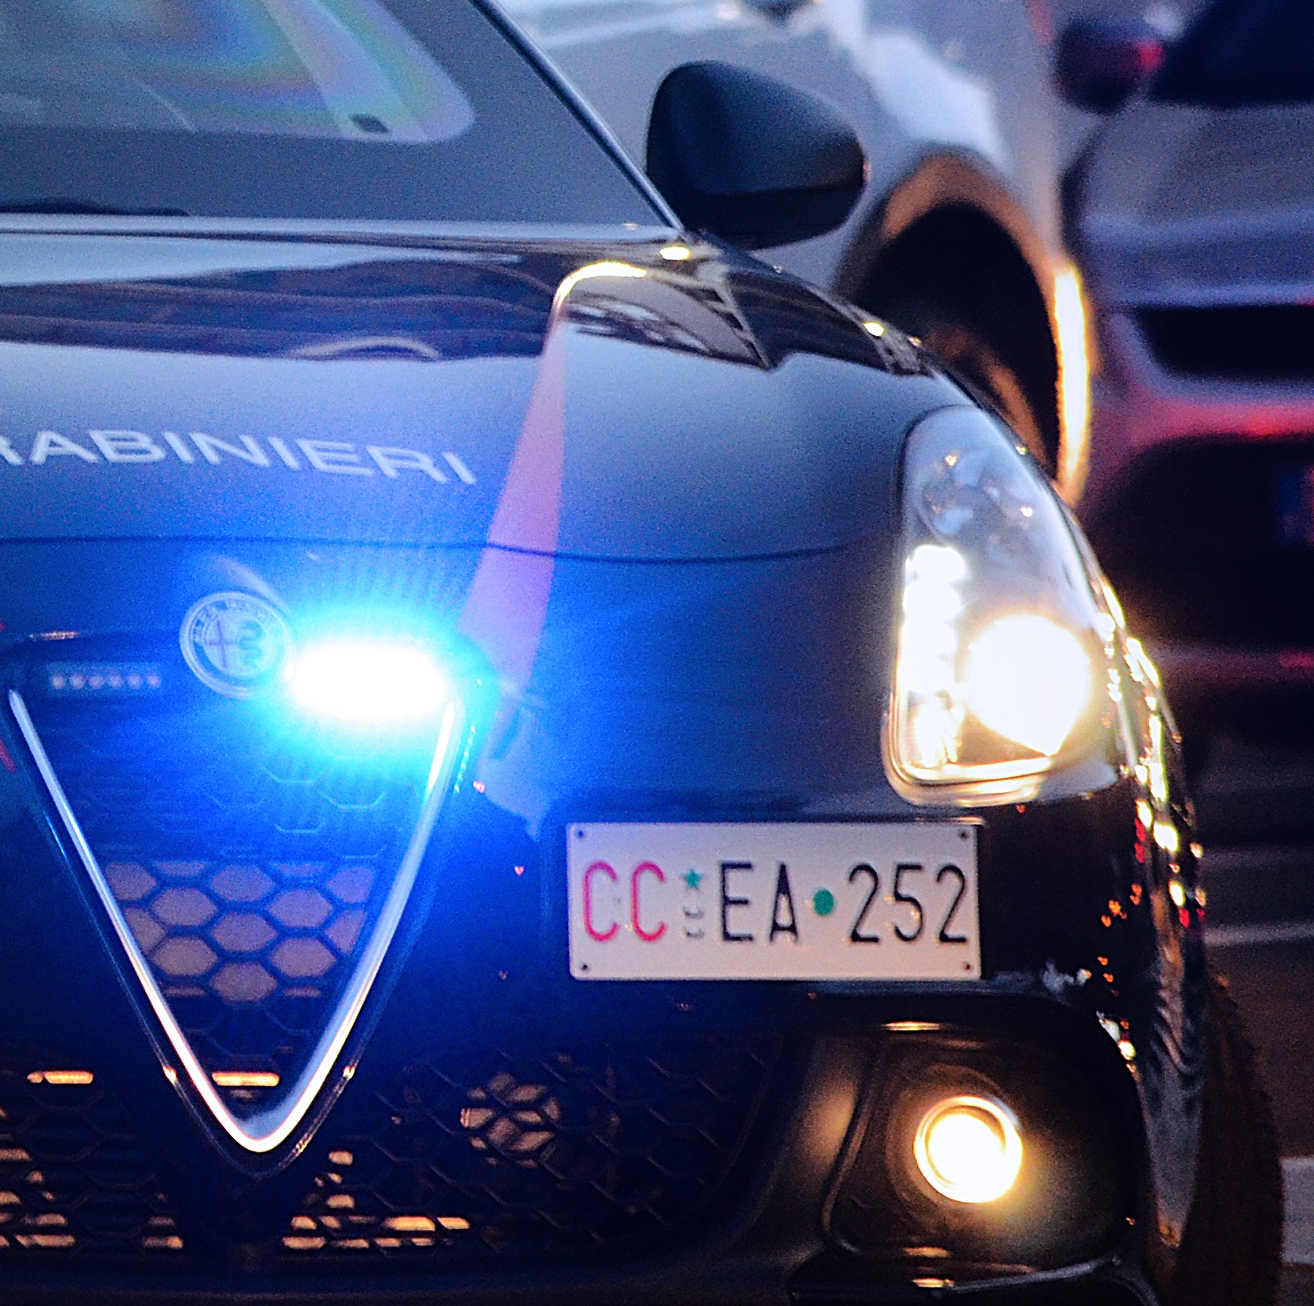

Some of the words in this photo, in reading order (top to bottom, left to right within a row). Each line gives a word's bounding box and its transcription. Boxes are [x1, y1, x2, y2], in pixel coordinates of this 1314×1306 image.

[582, 861, 667, 943] CC
[719, 861, 800, 944] EA
[847, 862, 968, 944] 252
